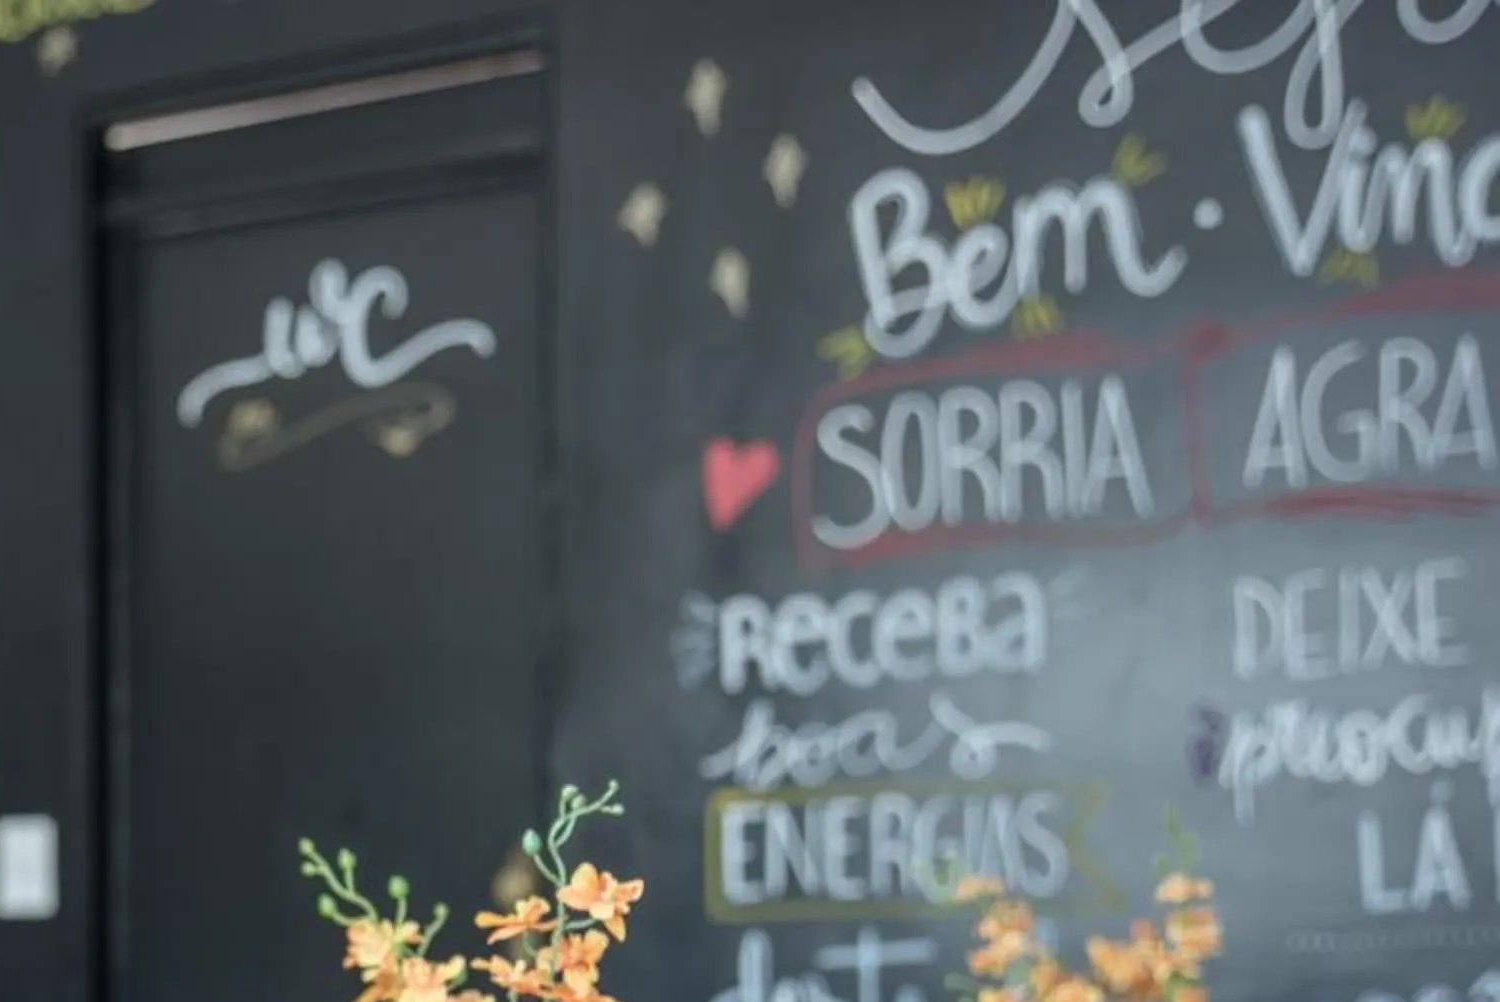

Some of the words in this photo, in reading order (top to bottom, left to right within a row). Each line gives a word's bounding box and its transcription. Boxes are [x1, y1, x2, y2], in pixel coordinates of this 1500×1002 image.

[847, 168, 1188, 358] Bem
[810, 374, 1155, 549] SORRIA
[1232, 555, 1472, 680] DEIXE
[719, 790, 1069, 905] ENERGIAS
[1358, 777, 1472, 914] LÁ
